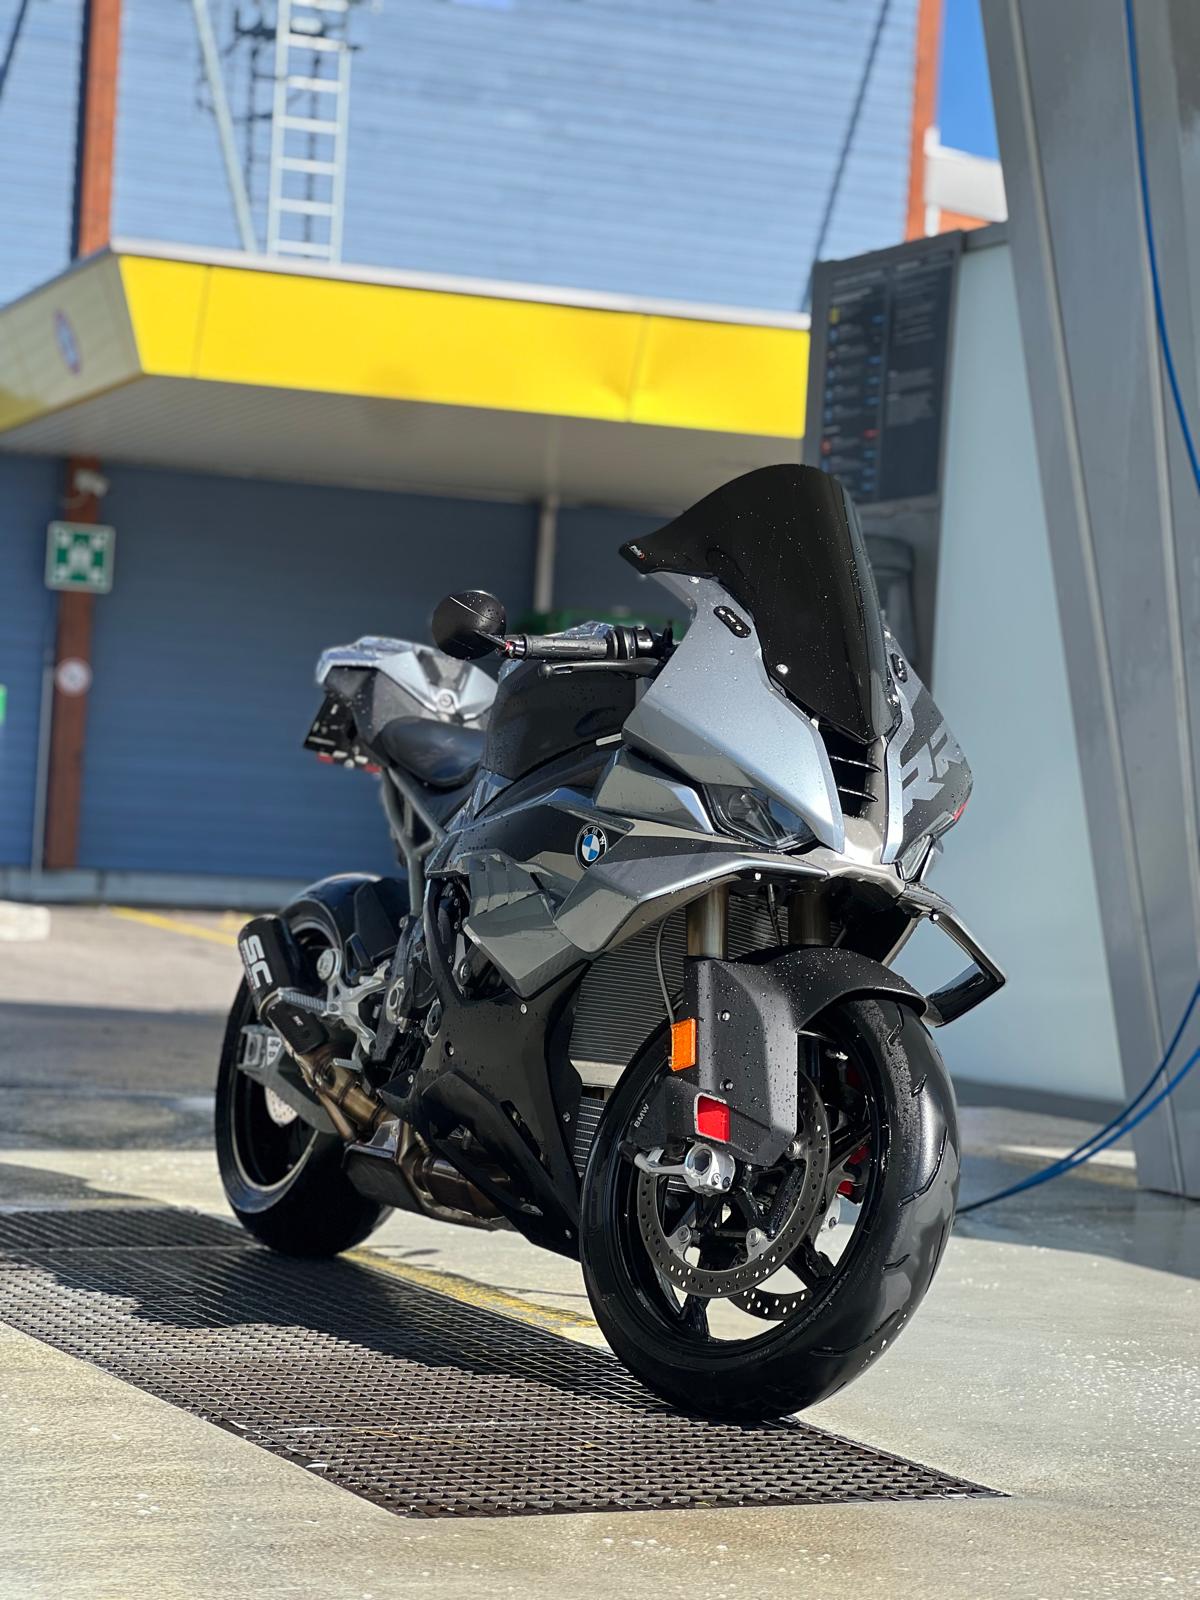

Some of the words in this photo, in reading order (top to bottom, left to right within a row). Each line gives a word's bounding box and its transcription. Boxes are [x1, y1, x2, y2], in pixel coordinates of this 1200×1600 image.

[582, 827, 606, 845] BMW
[241, 934, 273, 990] SC
[633, 1103, 649, 1128] BMW
